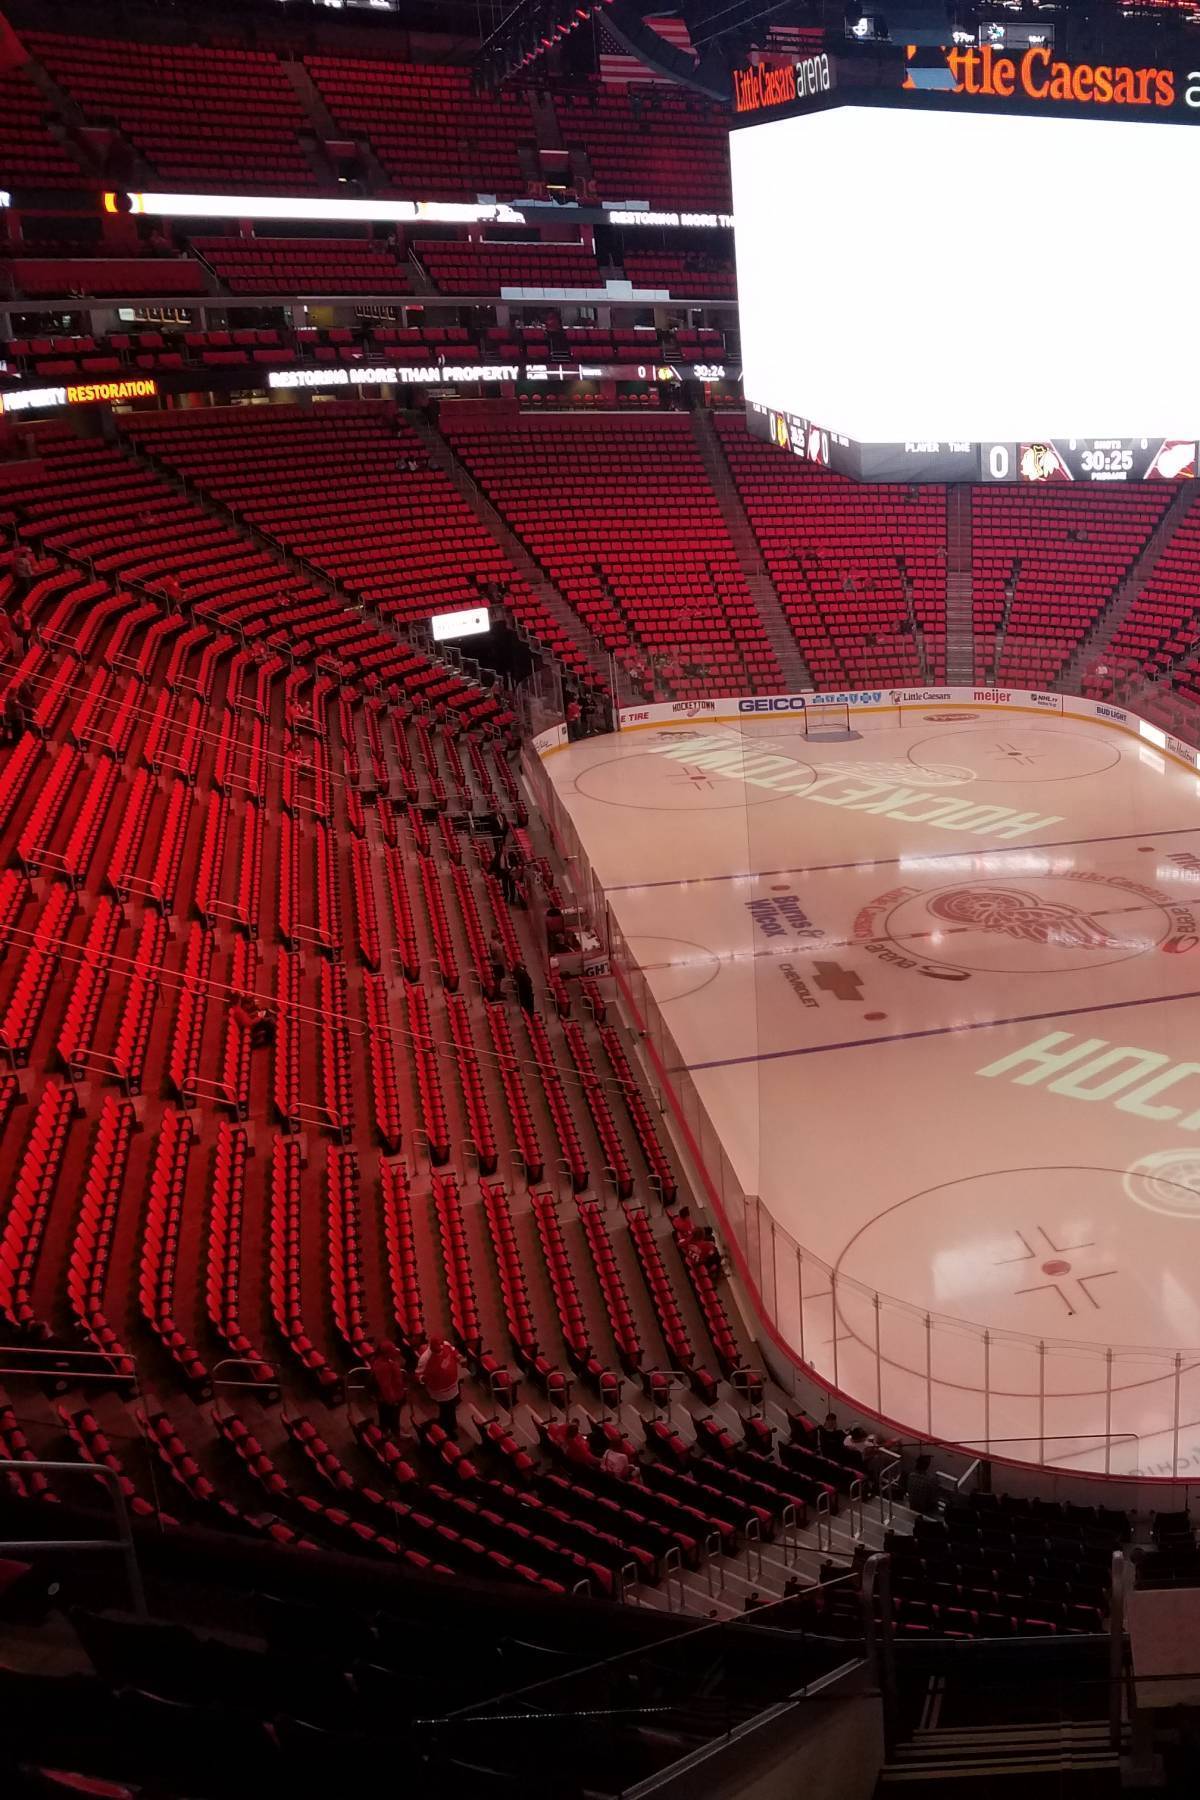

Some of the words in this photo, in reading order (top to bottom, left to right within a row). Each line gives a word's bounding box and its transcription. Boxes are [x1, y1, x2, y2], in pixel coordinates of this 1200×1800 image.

[734, 66, 758, 112] Little
[758, 62, 795, 108] Caesars
[796, 53, 830, 97] arena
[903, 45, 1015, 95] ttle
[1022, 46, 1175, 106] Caesars
[268, 369, 348, 387] RESTORING
[349, 368, 398, 383] MORE
[399, 367, 440, 382] THAN
[442, 366, 519, 381] PROPERTY
[637, 365, 646, 378] 0
[693, 364, 725, 378] 30:24
[67, 380, 157, 402] RESTORATION
[904, 442, 940, 453] PLAYER
[989, 445, 1009, 479] 0
[1081, 450, 1133, 471] 30:25
[672, 700, 715, 713] HOCKEYTOWN
[739, 697, 806, 713] GEICO
[903, 692, 922, 701] Little
[923, 692, 951, 701] Caesars
[973, 689, 1011, 704] meijer
[630, 711, 649, 721] TIRE
[1096, 706, 1110, 716] BUD
[1110, 711, 1127, 721] LIGHT
[647, 734, 1066, 839] HOCKEYTOWN
[744, 899, 787, 937] Wilcox
[772, 896, 812, 929] Burns
[797, 930, 825, 938] &
[1171, 907, 1196, 933] arena
[865, 944, 917, 969] arena
[779, 963, 820, 1009] CHEVROLET
